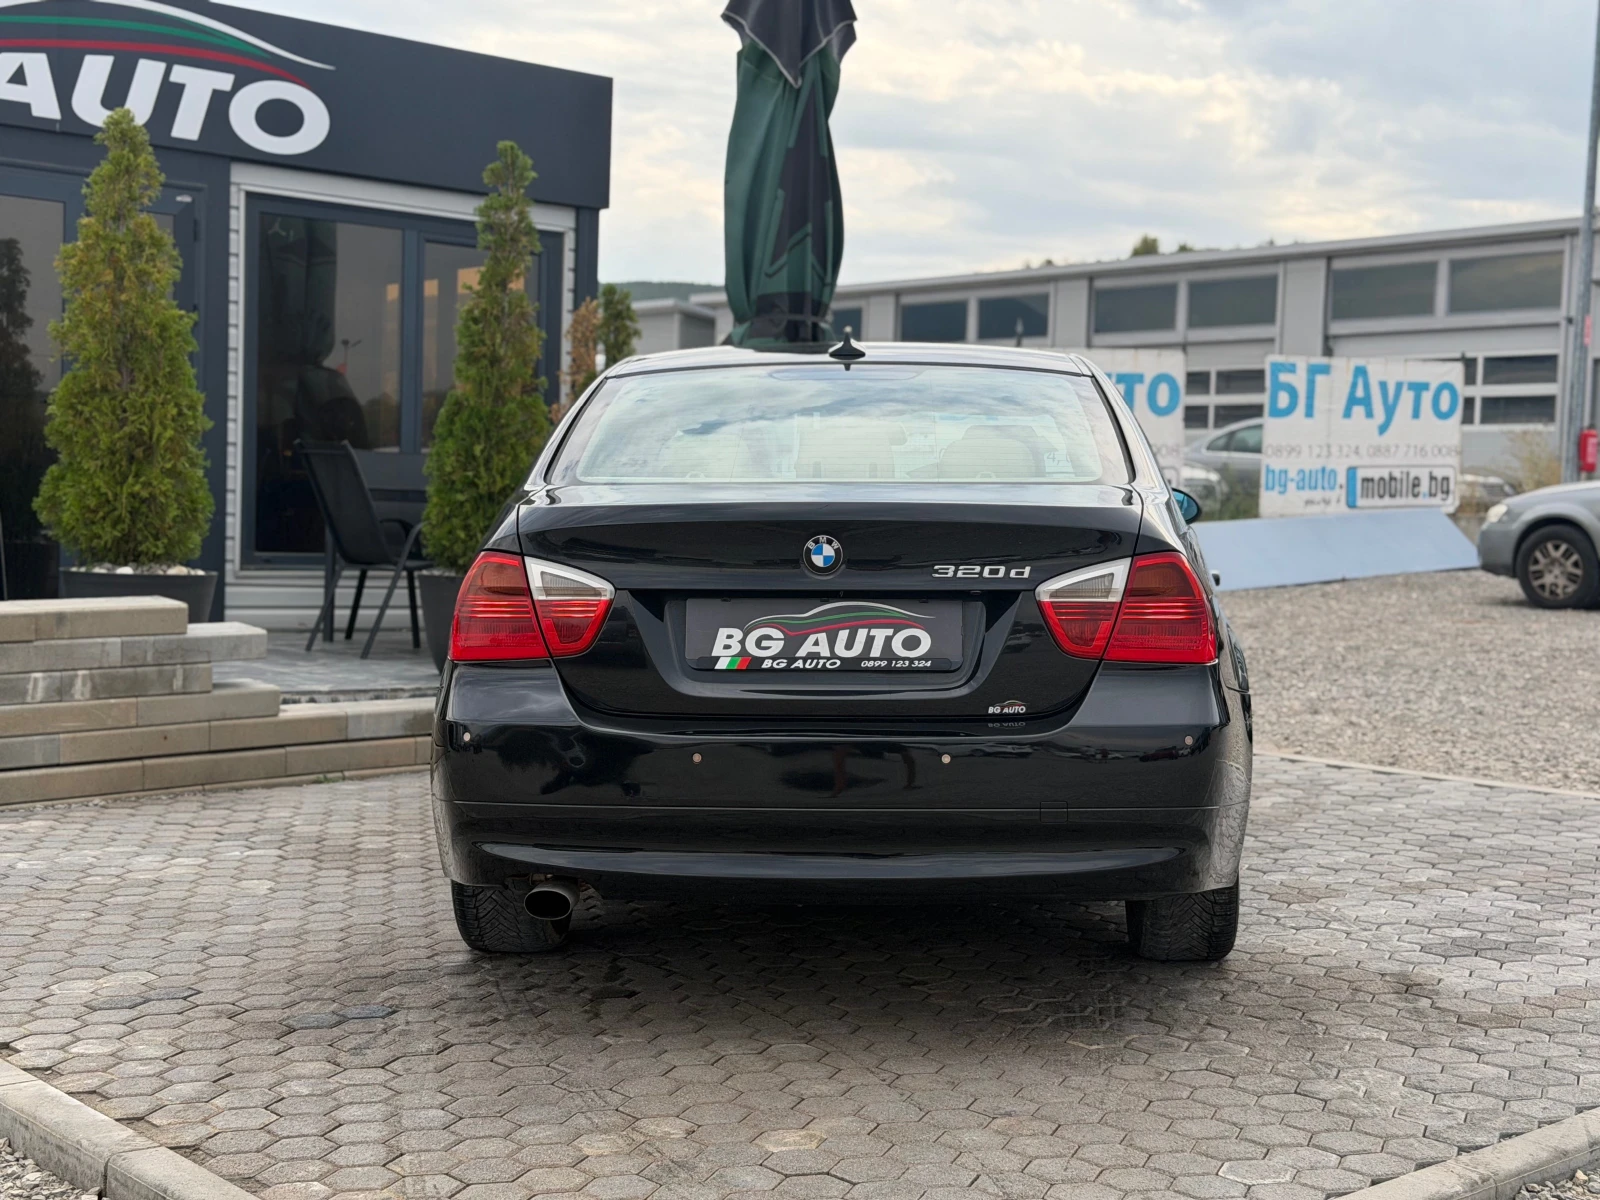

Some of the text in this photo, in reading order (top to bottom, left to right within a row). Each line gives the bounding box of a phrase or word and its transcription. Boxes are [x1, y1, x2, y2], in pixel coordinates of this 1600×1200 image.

[0, 52, 331, 155] AUTO
[1104, 371, 1182, 417] то
[1267, 361, 1460, 437] БГ Ауто
[1403, 443, 1429, 459] 716
[1360, 471, 1451, 501] mobile.bg
[807, 536, 840, 550] BMW
[931, 565, 1032, 579] 320d
[711, 627, 932, 658] BG AUTO
[761, 658, 932, 669] BG AUTO 0899 123 324
[987, 705, 1026, 714] BG AUTO
